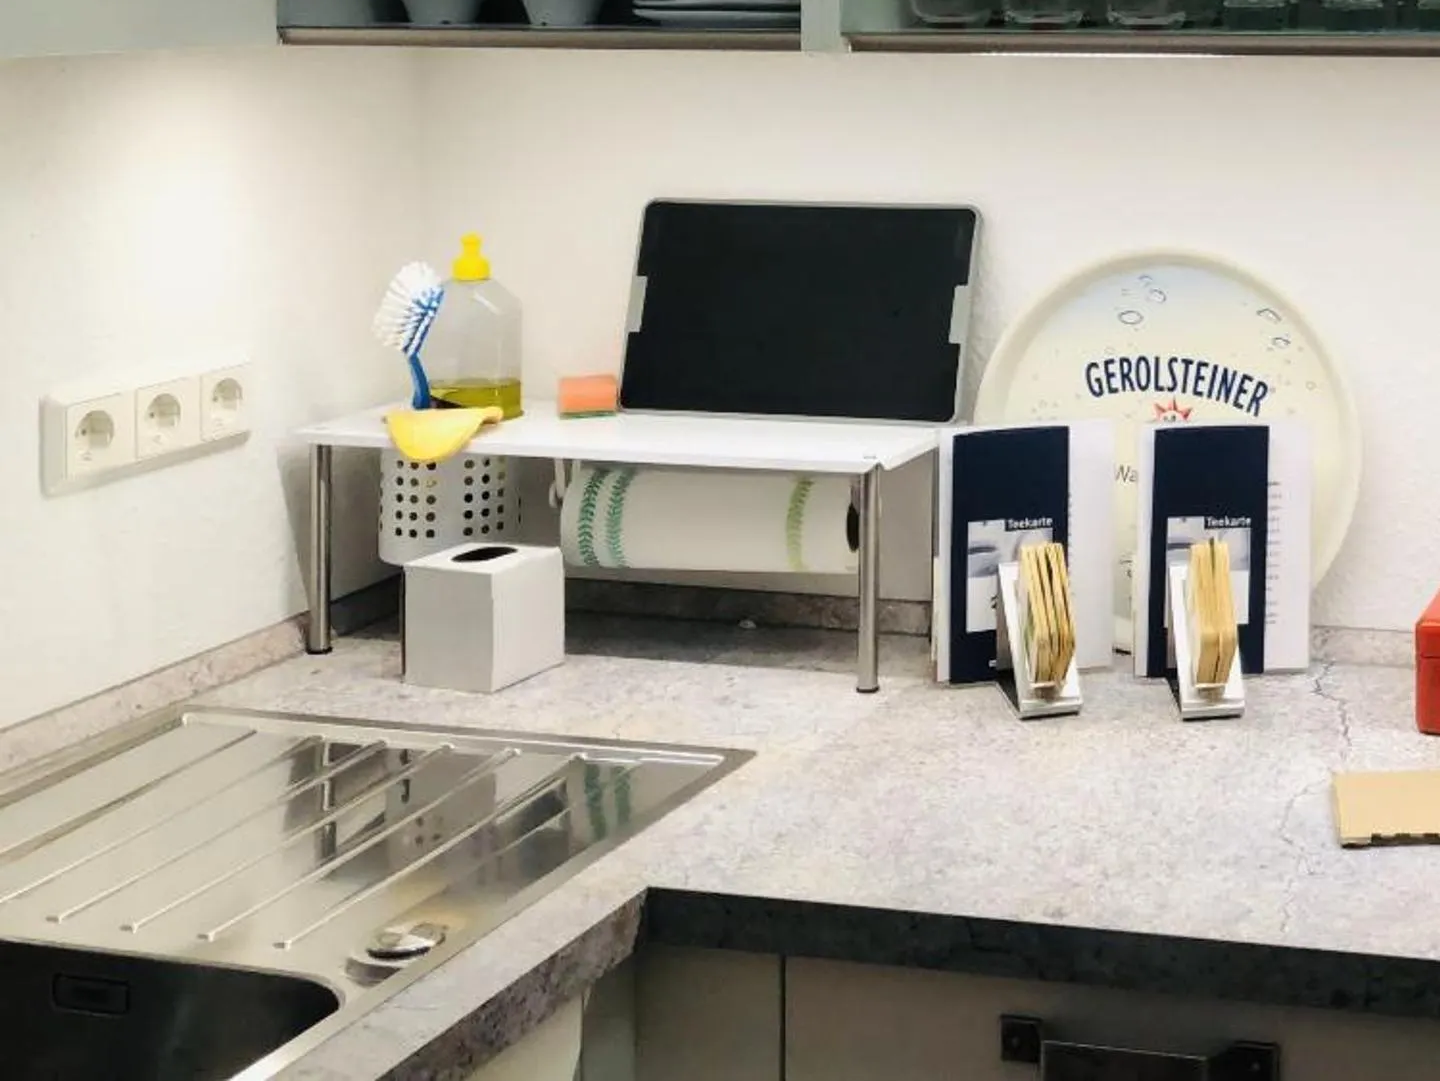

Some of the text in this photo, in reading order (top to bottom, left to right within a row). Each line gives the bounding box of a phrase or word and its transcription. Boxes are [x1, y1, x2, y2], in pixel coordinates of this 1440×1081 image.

[1085, 355, 1269, 418] GEROLSTEINER
[1007, 517, 1053, 531] Teekarte
[1206, 516, 1252, 529] Teekarte
